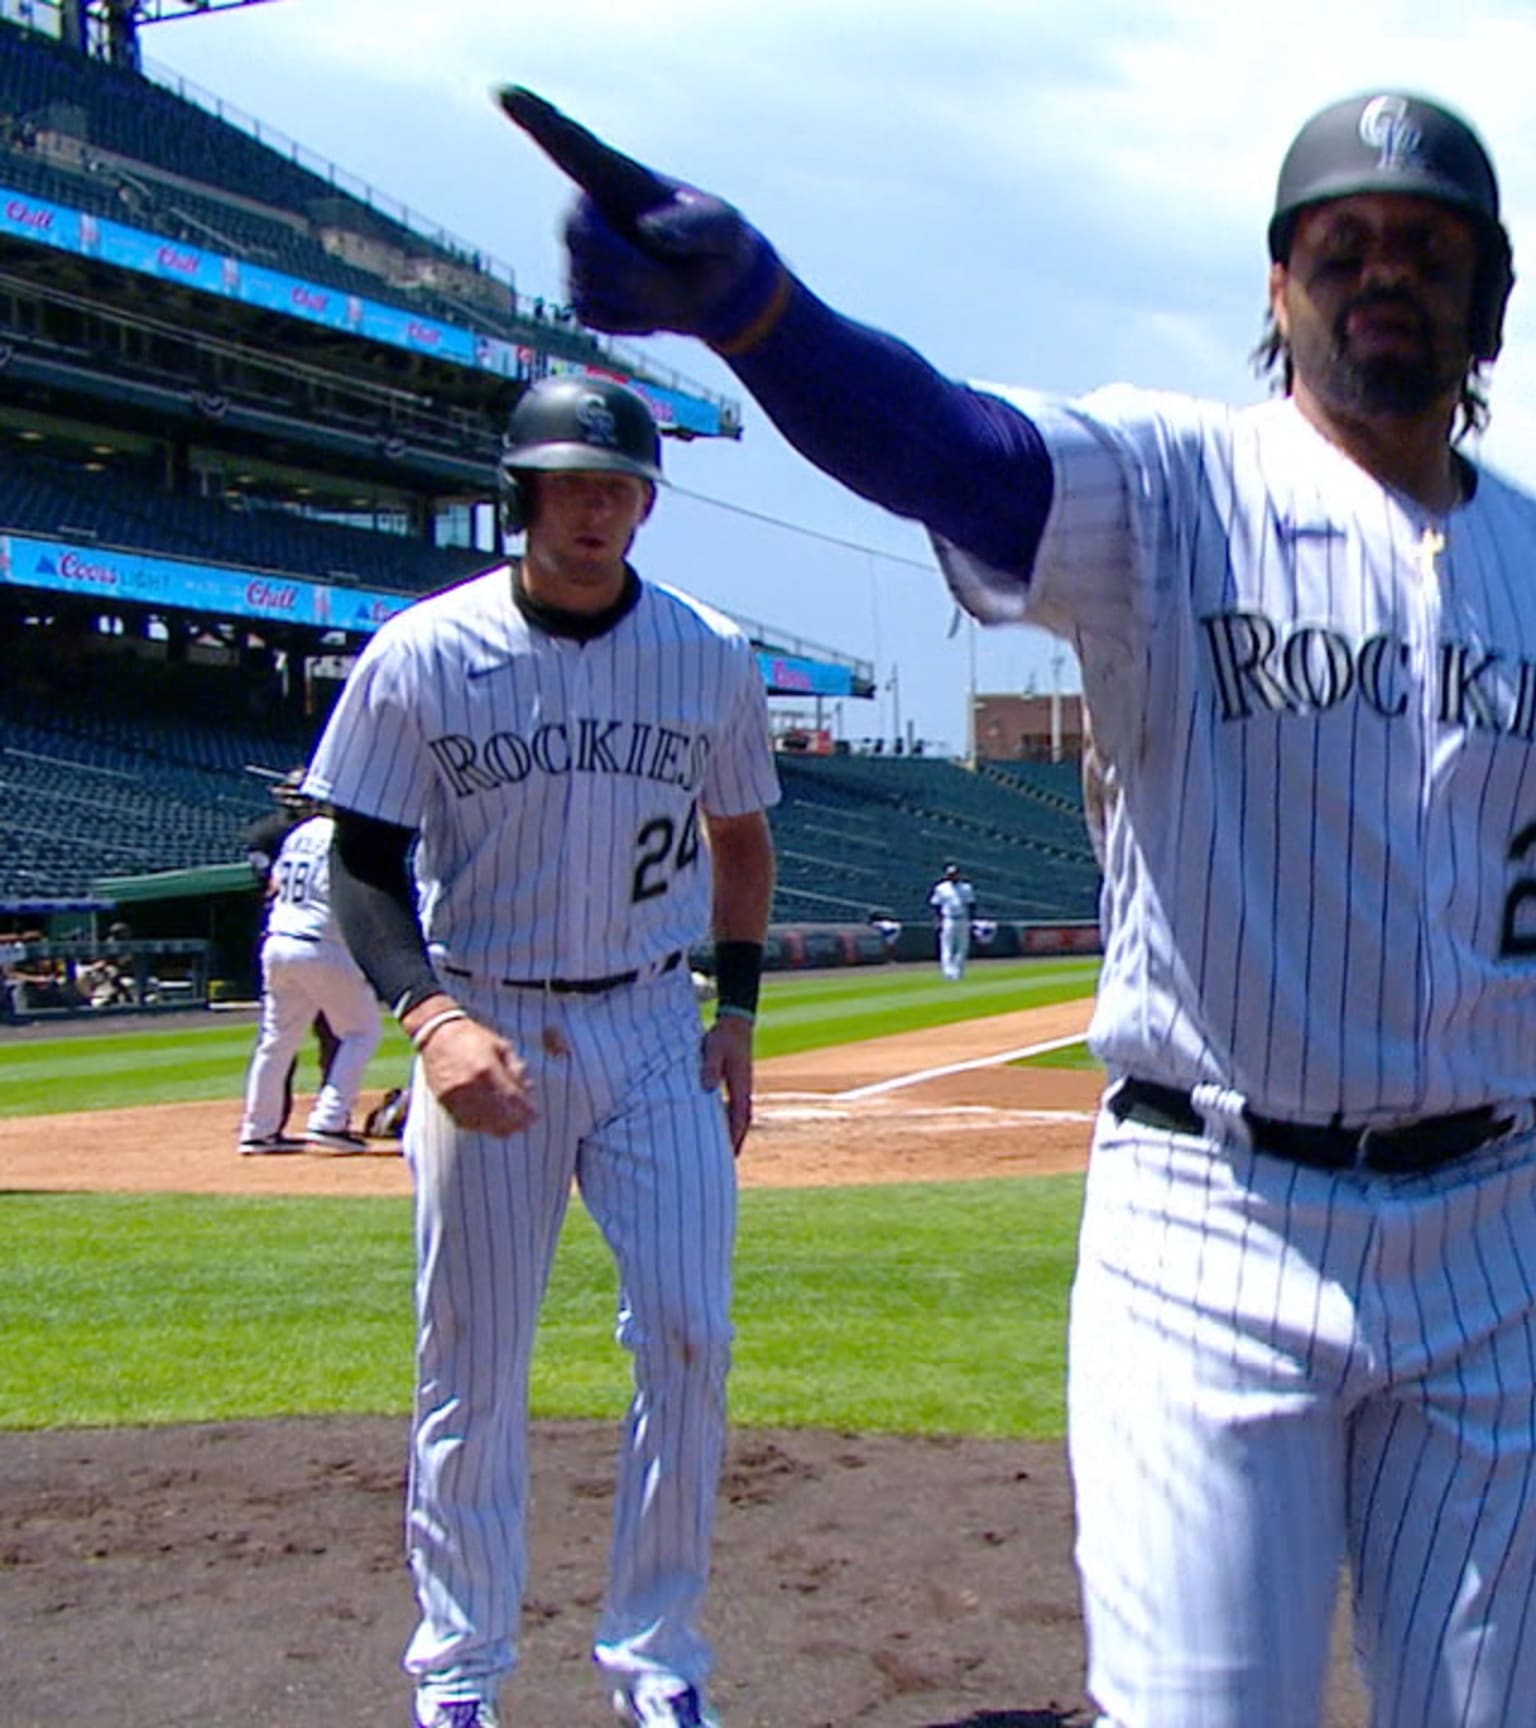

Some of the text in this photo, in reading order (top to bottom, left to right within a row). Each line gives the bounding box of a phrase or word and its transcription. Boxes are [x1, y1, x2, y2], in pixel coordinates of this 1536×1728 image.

[6, 201, 53, 229] Chill
[60, 553, 117, 585] Coors
[246, 579, 296, 610] Chill
[429, 717, 711, 798] ROCKIES
